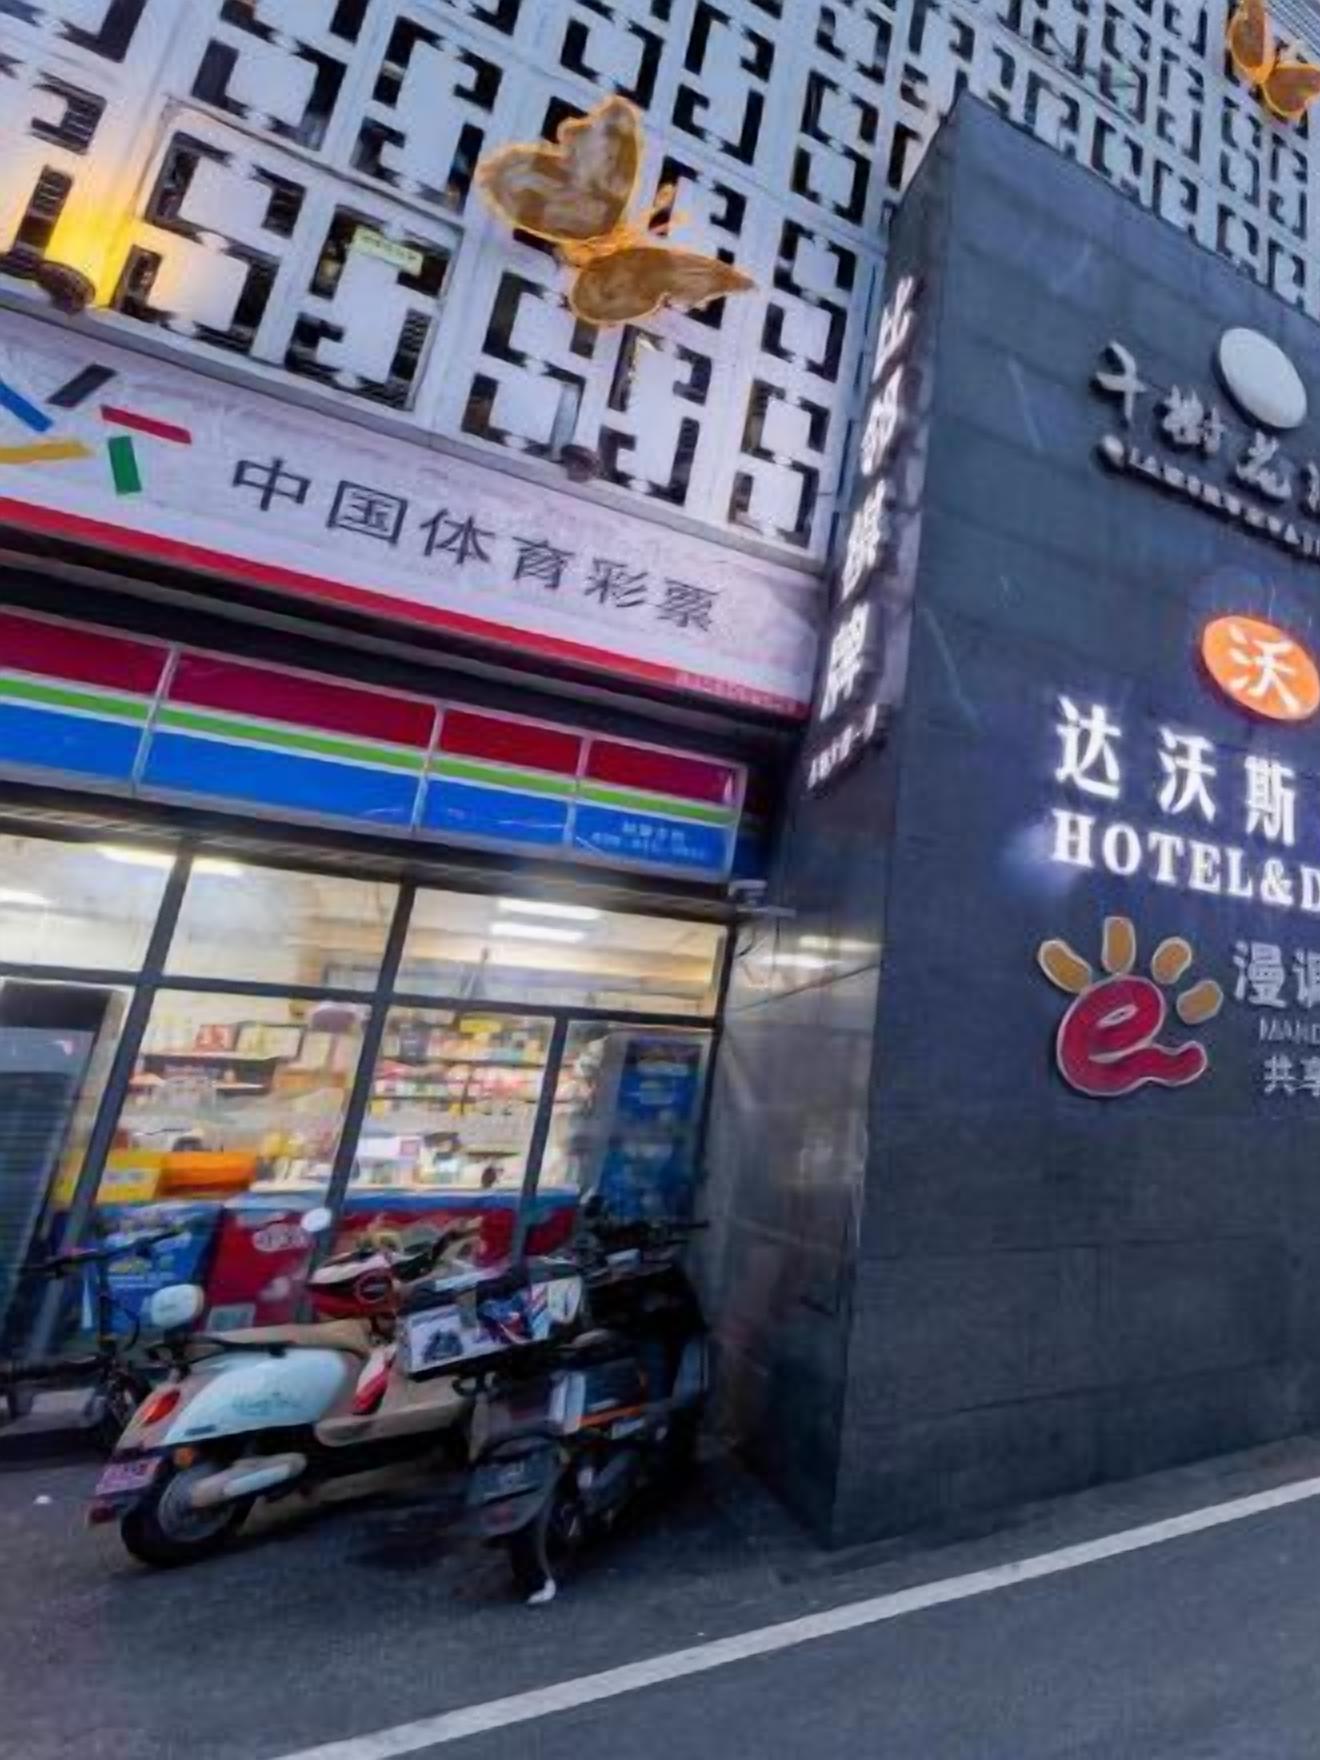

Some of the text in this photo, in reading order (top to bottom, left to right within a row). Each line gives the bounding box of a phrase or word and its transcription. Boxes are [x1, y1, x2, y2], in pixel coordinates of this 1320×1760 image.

[232, 455, 721, 633] 中国体育彩票
[1228, 622, 1302, 708] 沃
